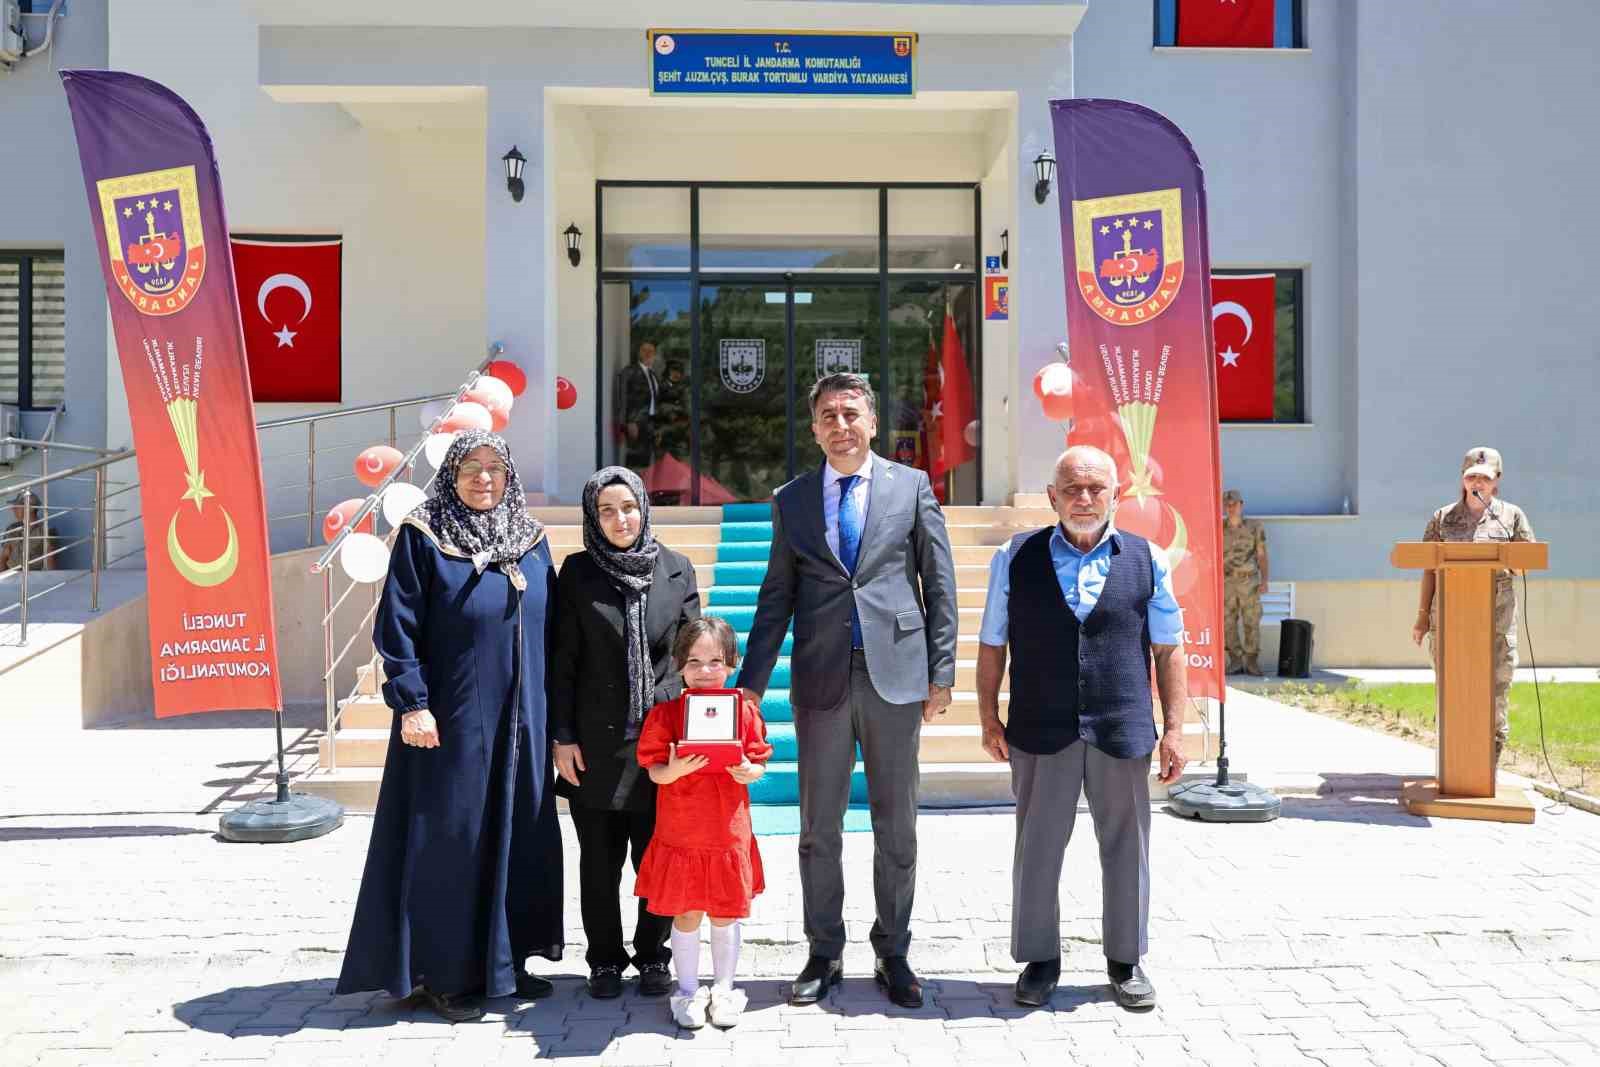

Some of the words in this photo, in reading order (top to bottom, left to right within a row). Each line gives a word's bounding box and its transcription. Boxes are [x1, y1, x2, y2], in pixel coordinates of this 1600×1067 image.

[775, 42, 791, 53] T.C.
[705, 55, 739, 68] TUNCELİ
[744, 55, 751, 68] İL
[755, 57, 800, 68] JANDARMA
[805, 56, 861, 69] KOMUTANLIĞI
[658, 70, 682, 84] ŞEHİT
[731, 72, 760, 83] BURAK
[764, 72, 808, 83] TORTUMLU
[813, 71, 848, 84] VARDİYA
[851, 72, 908, 84] YATAKHANESİ
